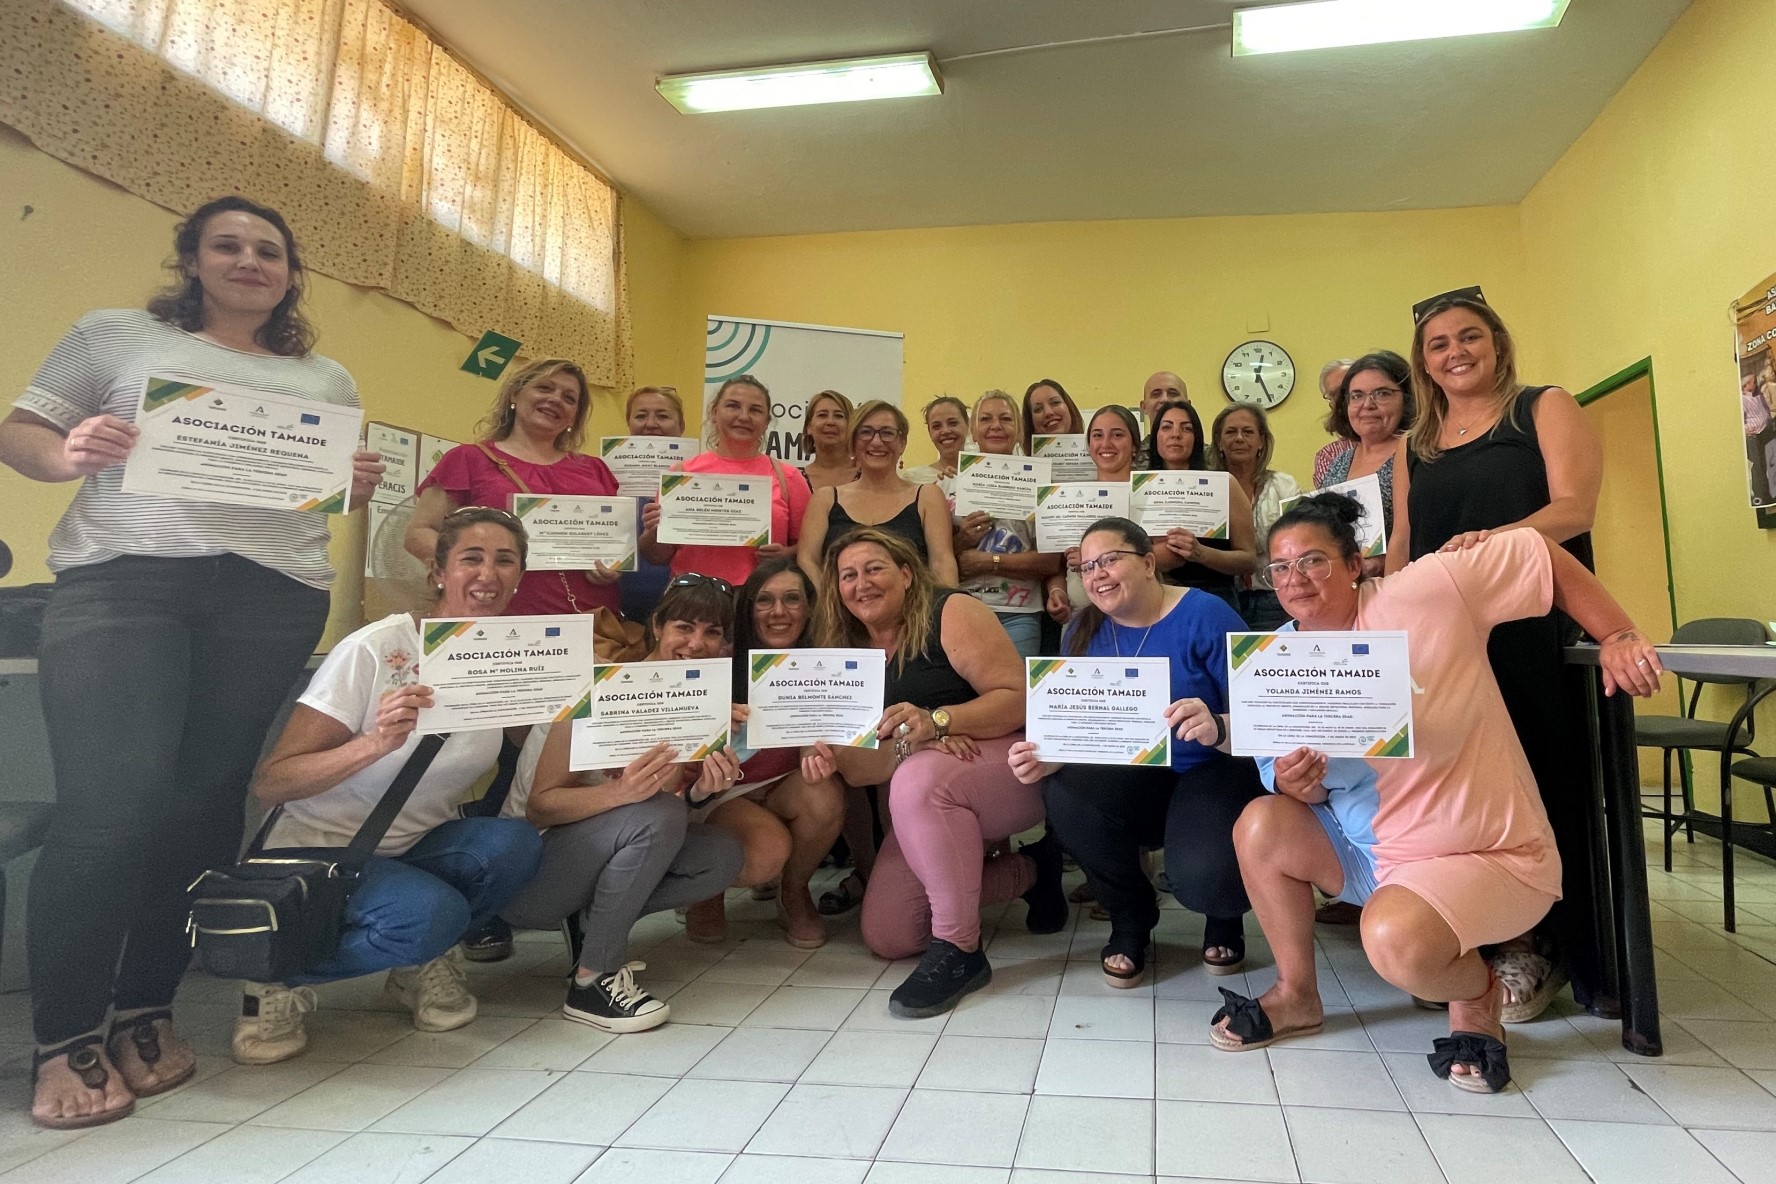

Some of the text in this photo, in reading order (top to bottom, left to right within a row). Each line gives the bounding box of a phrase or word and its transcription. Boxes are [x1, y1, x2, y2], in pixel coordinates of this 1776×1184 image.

[1747, 335, 1766, 352] ZONA
[172, 416, 327, 447] ASOCIACIÓN TAMAIDE
[176, 435, 309, 459] ESTEFANÍA JIMÉNEZ REQUENA
[448, 648, 569, 661] ASOCIACIÓN TAMAIDE
[1254, 667, 1381, 678] ASOCIACIÓN TAMAIDE
[770, 678, 826, 687] ASOCIACIÓN
[598, 689, 708, 702] ASOCIACIÓN TAMAIDE
[1047, 686, 1147, 697] ASOCIACIÓN TAMAIDE
